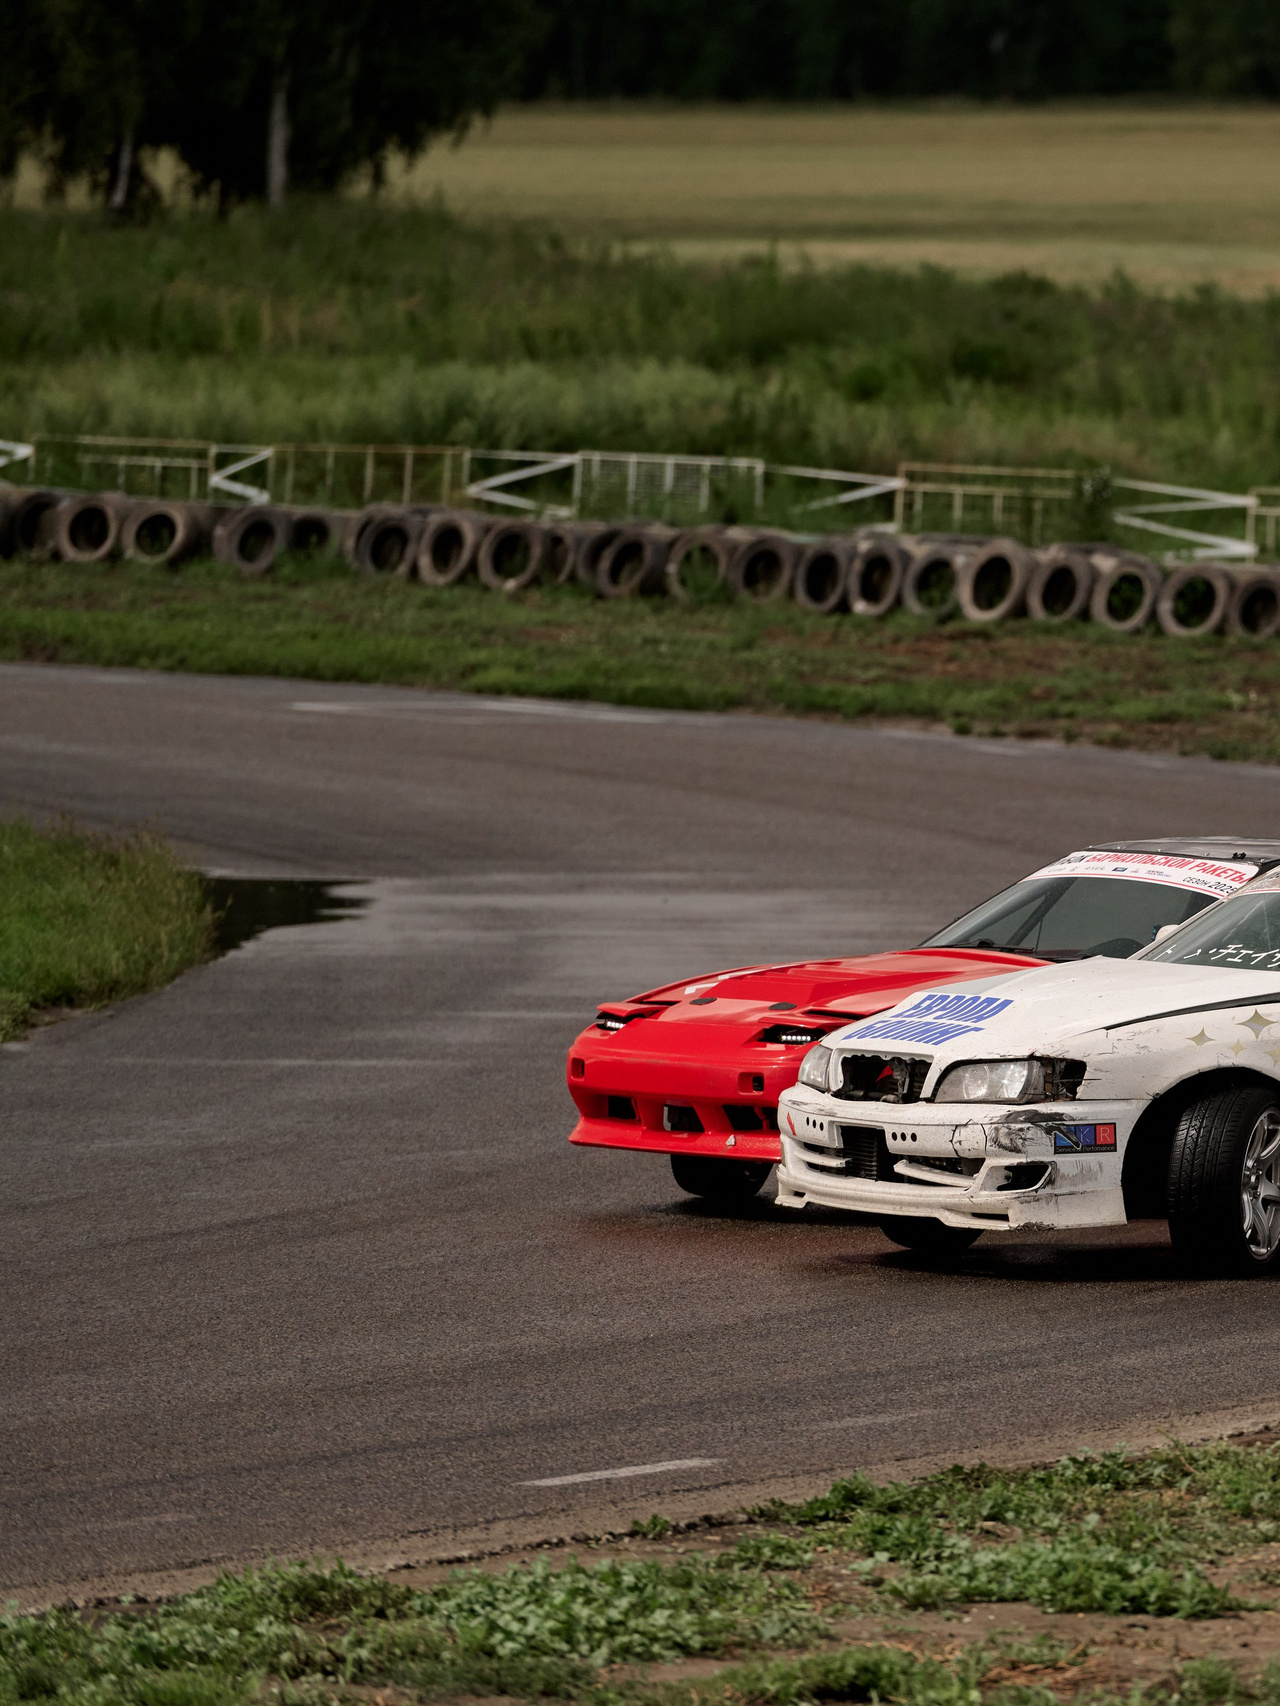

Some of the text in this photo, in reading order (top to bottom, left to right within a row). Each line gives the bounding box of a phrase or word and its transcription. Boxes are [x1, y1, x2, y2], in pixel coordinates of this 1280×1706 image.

[1084, 853, 1196, 870] БАРНАУЛЬСКОЙ
[890, 994, 1015, 1024] ЕВРОПА
[841, 1020, 986, 1046] БОУЛИНГ
